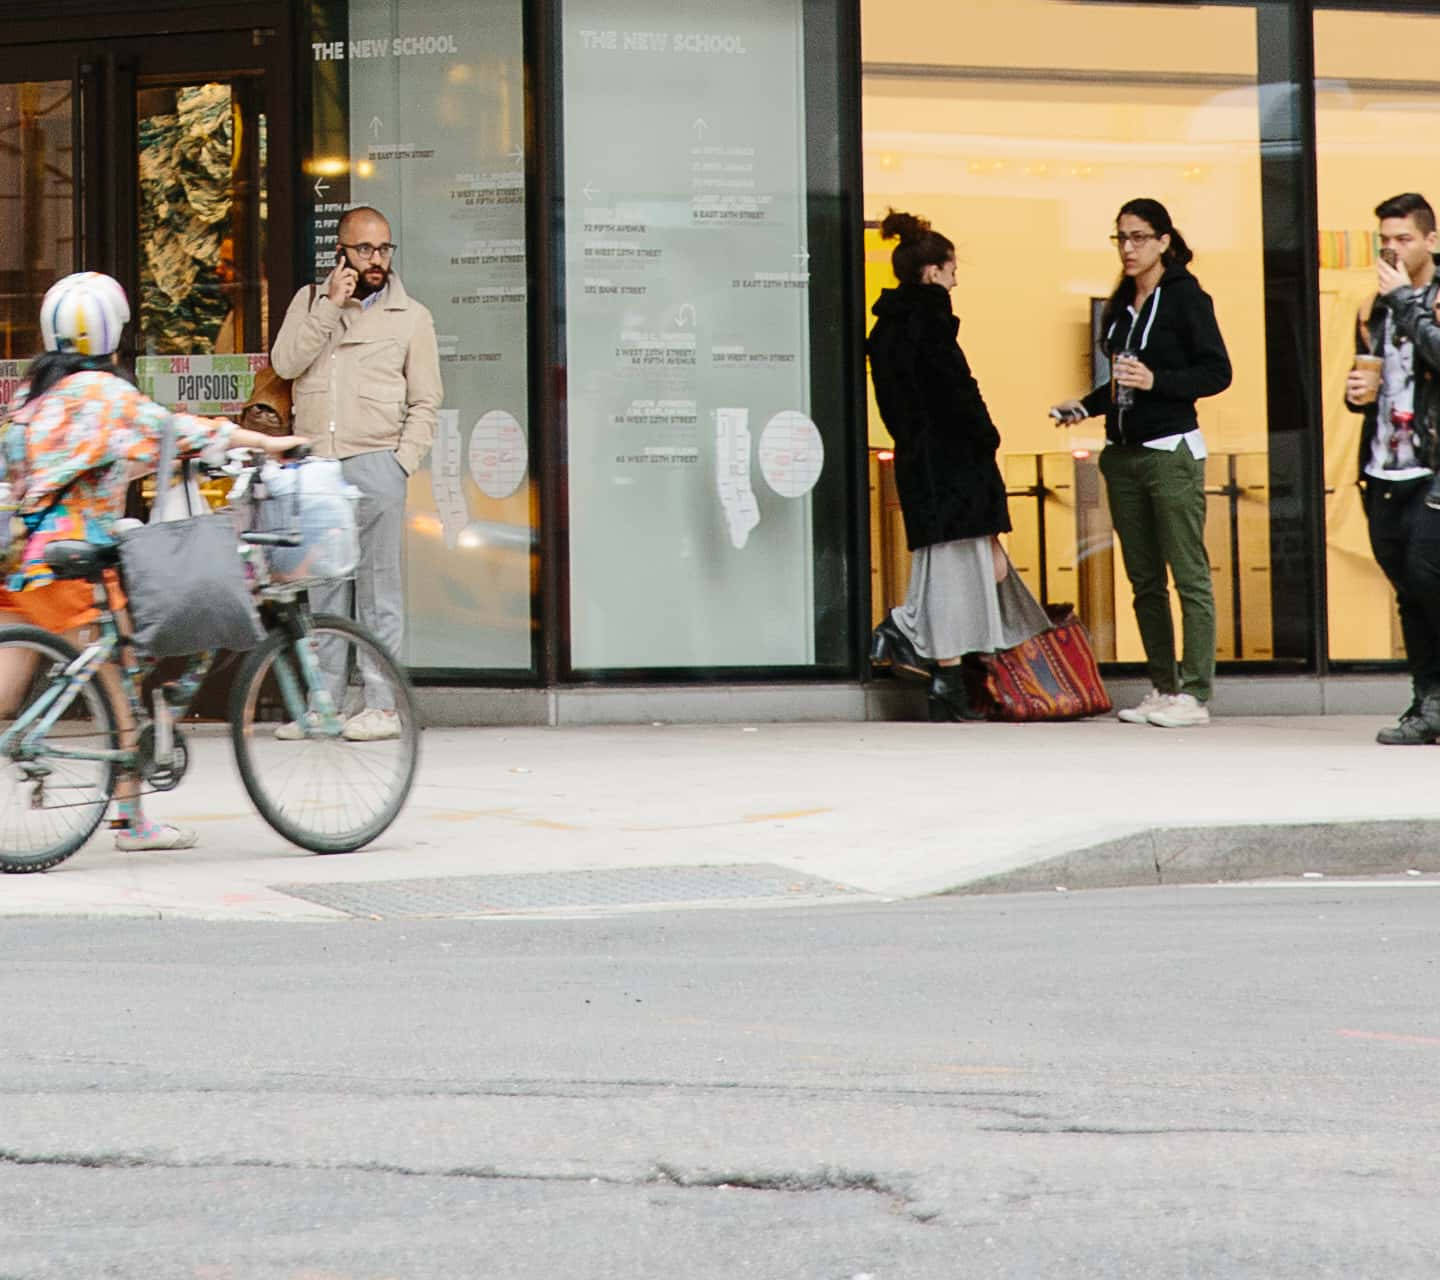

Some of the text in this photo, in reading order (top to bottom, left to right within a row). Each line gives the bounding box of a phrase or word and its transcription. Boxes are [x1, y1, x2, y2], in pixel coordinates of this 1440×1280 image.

[311, 35, 458, 61] THE NEW SCHOOL
[579, 30, 746, 55] THE NEW SCHOOL
